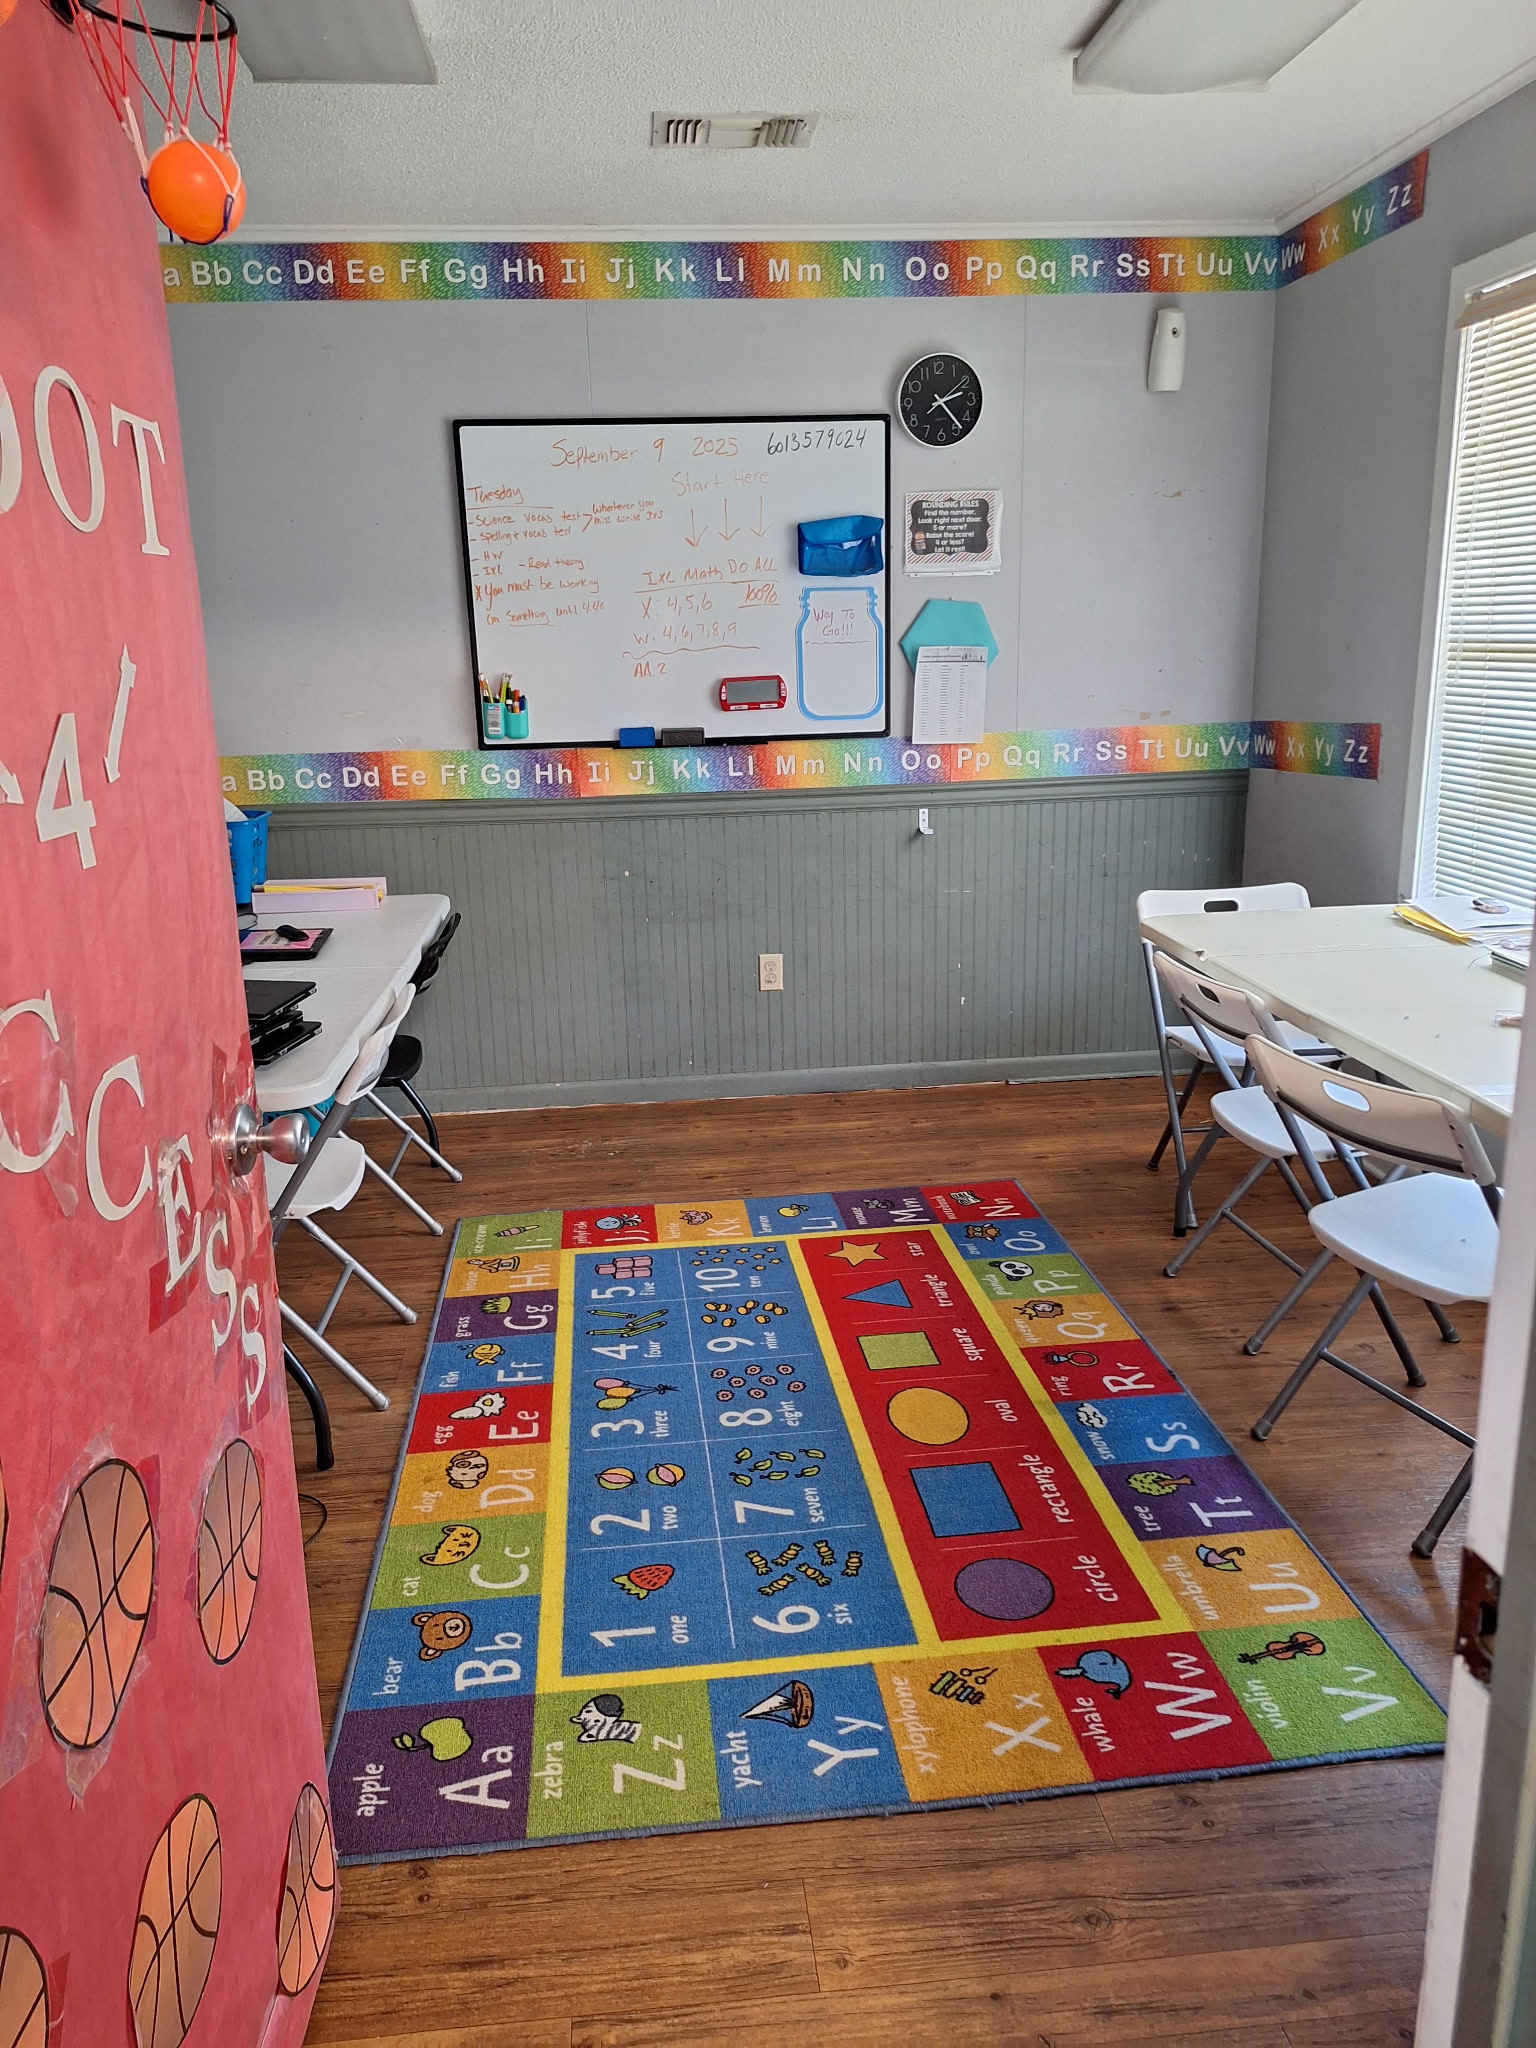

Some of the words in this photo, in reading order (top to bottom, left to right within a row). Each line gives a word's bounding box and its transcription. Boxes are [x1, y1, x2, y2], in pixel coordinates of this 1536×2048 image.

[191, 260, 232, 286] Bb
[243, 260, 283, 285] Cc
[294, 259, 334, 285] Dd
[347, 259, 385, 284] Ee
[401, 258, 430, 284] Ff
[444, 258, 488, 290] Gg
[503, 258, 544, 283] Hh
[560, 258, 586, 284] Ii
[605, 258, 634, 289] Jj
[655, 257, 697, 282] Kk
[716, 257, 744, 282] Ll
[768, 258, 822, 283] Mm
[843, 257, 885, 282] Nn
[905, 256, 950, 281] Oo
[966, 256, 1003, 286] Pp
[1016, 255, 1056, 284] Qq
[1070, 255, 1103, 278] Rr
[1116, 253, 1151, 277] Ss
[1158, 253, 1186, 276] Tt
[1196, 252, 1233, 276] Uu
[1244, 251, 1278, 276] Vv
[1280, 242, 1306, 271] Ww
[1317, 223, 1340, 253] Xx
[1350, 203, 1376, 234] Yy
[1385, 183, 1413, 217] Zz
[933, 361, 945, 374] 12
[908, 381, 921, 393] 10
[966, 392, 976, 406] 3
[904, 397, 913, 411] 9
[937, 428, 946, 441] 6
[551, 438, 638, 470] September
[653, 438, 666, 463] 9
[692, 436, 739, 457] 2025
[467, 484, 524, 504] Tuesday
[672, 471, 723, 496] Start
[734, 468, 769, 487] Here
[922, 501, 958, 509] ROUNDING
[960, 500, 979, 508] RULES
[540, 576, 553, 589] be
[685, 568, 722, 581] Math
[248, 769, 285, 791] Bb
[294, 768, 332, 790] Cc
[342, 766, 381, 788] Dd
[391, 764, 427, 787] Ee
[440, 764, 469, 786] Ff
[480, 763, 522, 790] Gg
[535, 763, 573, 785] Hh
[587, 761, 610, 784] Ii
[628, 760, 656, 786] Jj
[673, 758, 710, 780] Kk
[728, 755, 753, 777] Ll
[776, 755, 825, 776] Mm
[844, 752, 882, 773] Nn
[902, 749, 942, 771] Oo
[957, 748, 991, 771] Pp
[1003, 746, 1041, 769] Qq
[1053, 742, 1085, 764] Rr
[1096, 741, 1127, 761] Ss
[1139, 739, 1165, 760] Tt
[1174, 737, 1208, 759] Uu
[1219, 736, 1250, 757] Vv
[1253, 734, 1276, 756] Ww
[1286, 736, 1305, 759] Xx
[1314, 737, 1335, 767] Yy
[1344, 739, 1368, 764] Zz
[888, 1197, 930, 1223] Mm
[979, 1197, 1020, 1218] Nn
[604, 1229, 651, 1243] Jj
[706, 1217, 744, 1237] Kk
[906, 1241, 925, 1257] star
[1004, 1230, 1046, 1252] Oo
[509, 1264, 550, 1289] Hh
[695, 1267, 741, 1292] 10
[1033, 1270, 1081, 1293] Pp
[591, 1286, 636, 1299] 5
[920, 1274, 953, 1307] triangle
[504, 1304, 554, 1330] Gg
[1056, 1311, 1108, 1339] Qq
[591, 1343, 638, 1361] 4
[644, 1341, 661, 1358] four
[706, 1336, 755, 1352] 9
[760, 1331, 778, 1349] nine
[952, 1328, 982, 1362] square
[497, 1361, 543, 1382] Ff
[1102, 1362, 1155, 1393] Rr
[650, 1410, 670, 1438] three
[719, 1408, 773, 1427] 8
[777, 1400, 802, 1427] eight
[984, 1399, 1018, 1422] oval
[488, 1410, 540, 1441] Ee
[591, 1418, 645, 1439] 3
[1145, 1422, 1201, 1452] Ss
[1086, 1431, 1116, 1460] snow
[479, 1468, 537, 1509] Dd
[1018, 1454, 1075, 1524] rectangle
[662, 1506, 677, 1530] two
[734, 1500, 795, 1523] 7
[803, 1487, 825, 1523] seven
[1134, 1505, 1161, 1532] tree
[1189, 1496, 1254, 1528] Tt
[590, 1509, 650, 1536] 2
[469, 1546, 530, 1590] Cc
[1072, 1555, 1119, 1602] circle
[403, 1576, 421, 1597] cat
[1249, 1561, 1321, 1613] Uu
[752, 1604, 820, 1634] 6
[827, 1603, 853, 1625] six
[590, 1626, 656, 1648] 1
[671, 1615, 689, 1644] one
[454, 1632, 522, 1691] Bb
[372, 1658, 403, 1696] bear
[1144, 1652, 1232, 1741] Ww
[1321, 1665, 1400, 1722] Vv
[984, 1692, 1062, 1756] Xx
[1071, 1697, 1116, 1753] whale
[807, 1715, 883, 1776] Yy
[534, 1741, 564, 1800] zebra
[612, 1734, 686, 1794] Zz
[720, 1731, 763, 1789] yacht
[353, 1763, 390, 1817] apple
[438, 1745, 514, 1809] Aa
